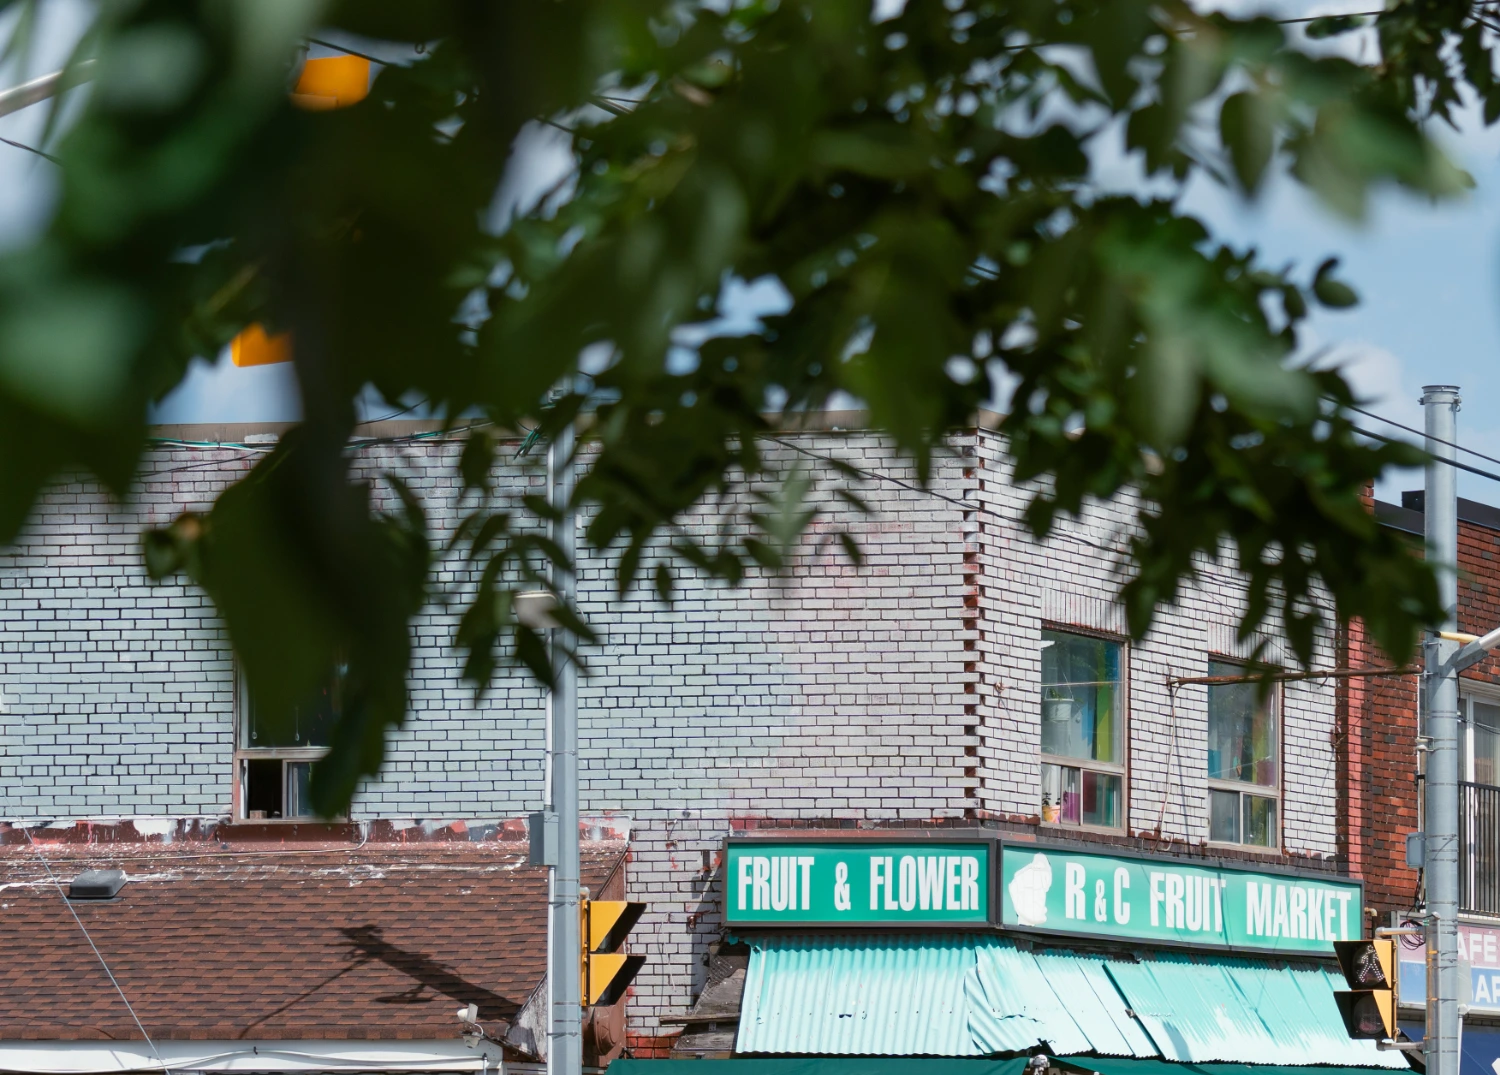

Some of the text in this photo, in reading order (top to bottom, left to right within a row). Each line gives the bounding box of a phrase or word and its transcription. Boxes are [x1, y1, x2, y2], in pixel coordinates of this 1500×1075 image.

[738, 855, 980, 911] FRUIT & FLOWER
[1065, 861, 1352, 942] R & C FRUIT MARKET
[1457, 931, 1498, 963] AFÉ
